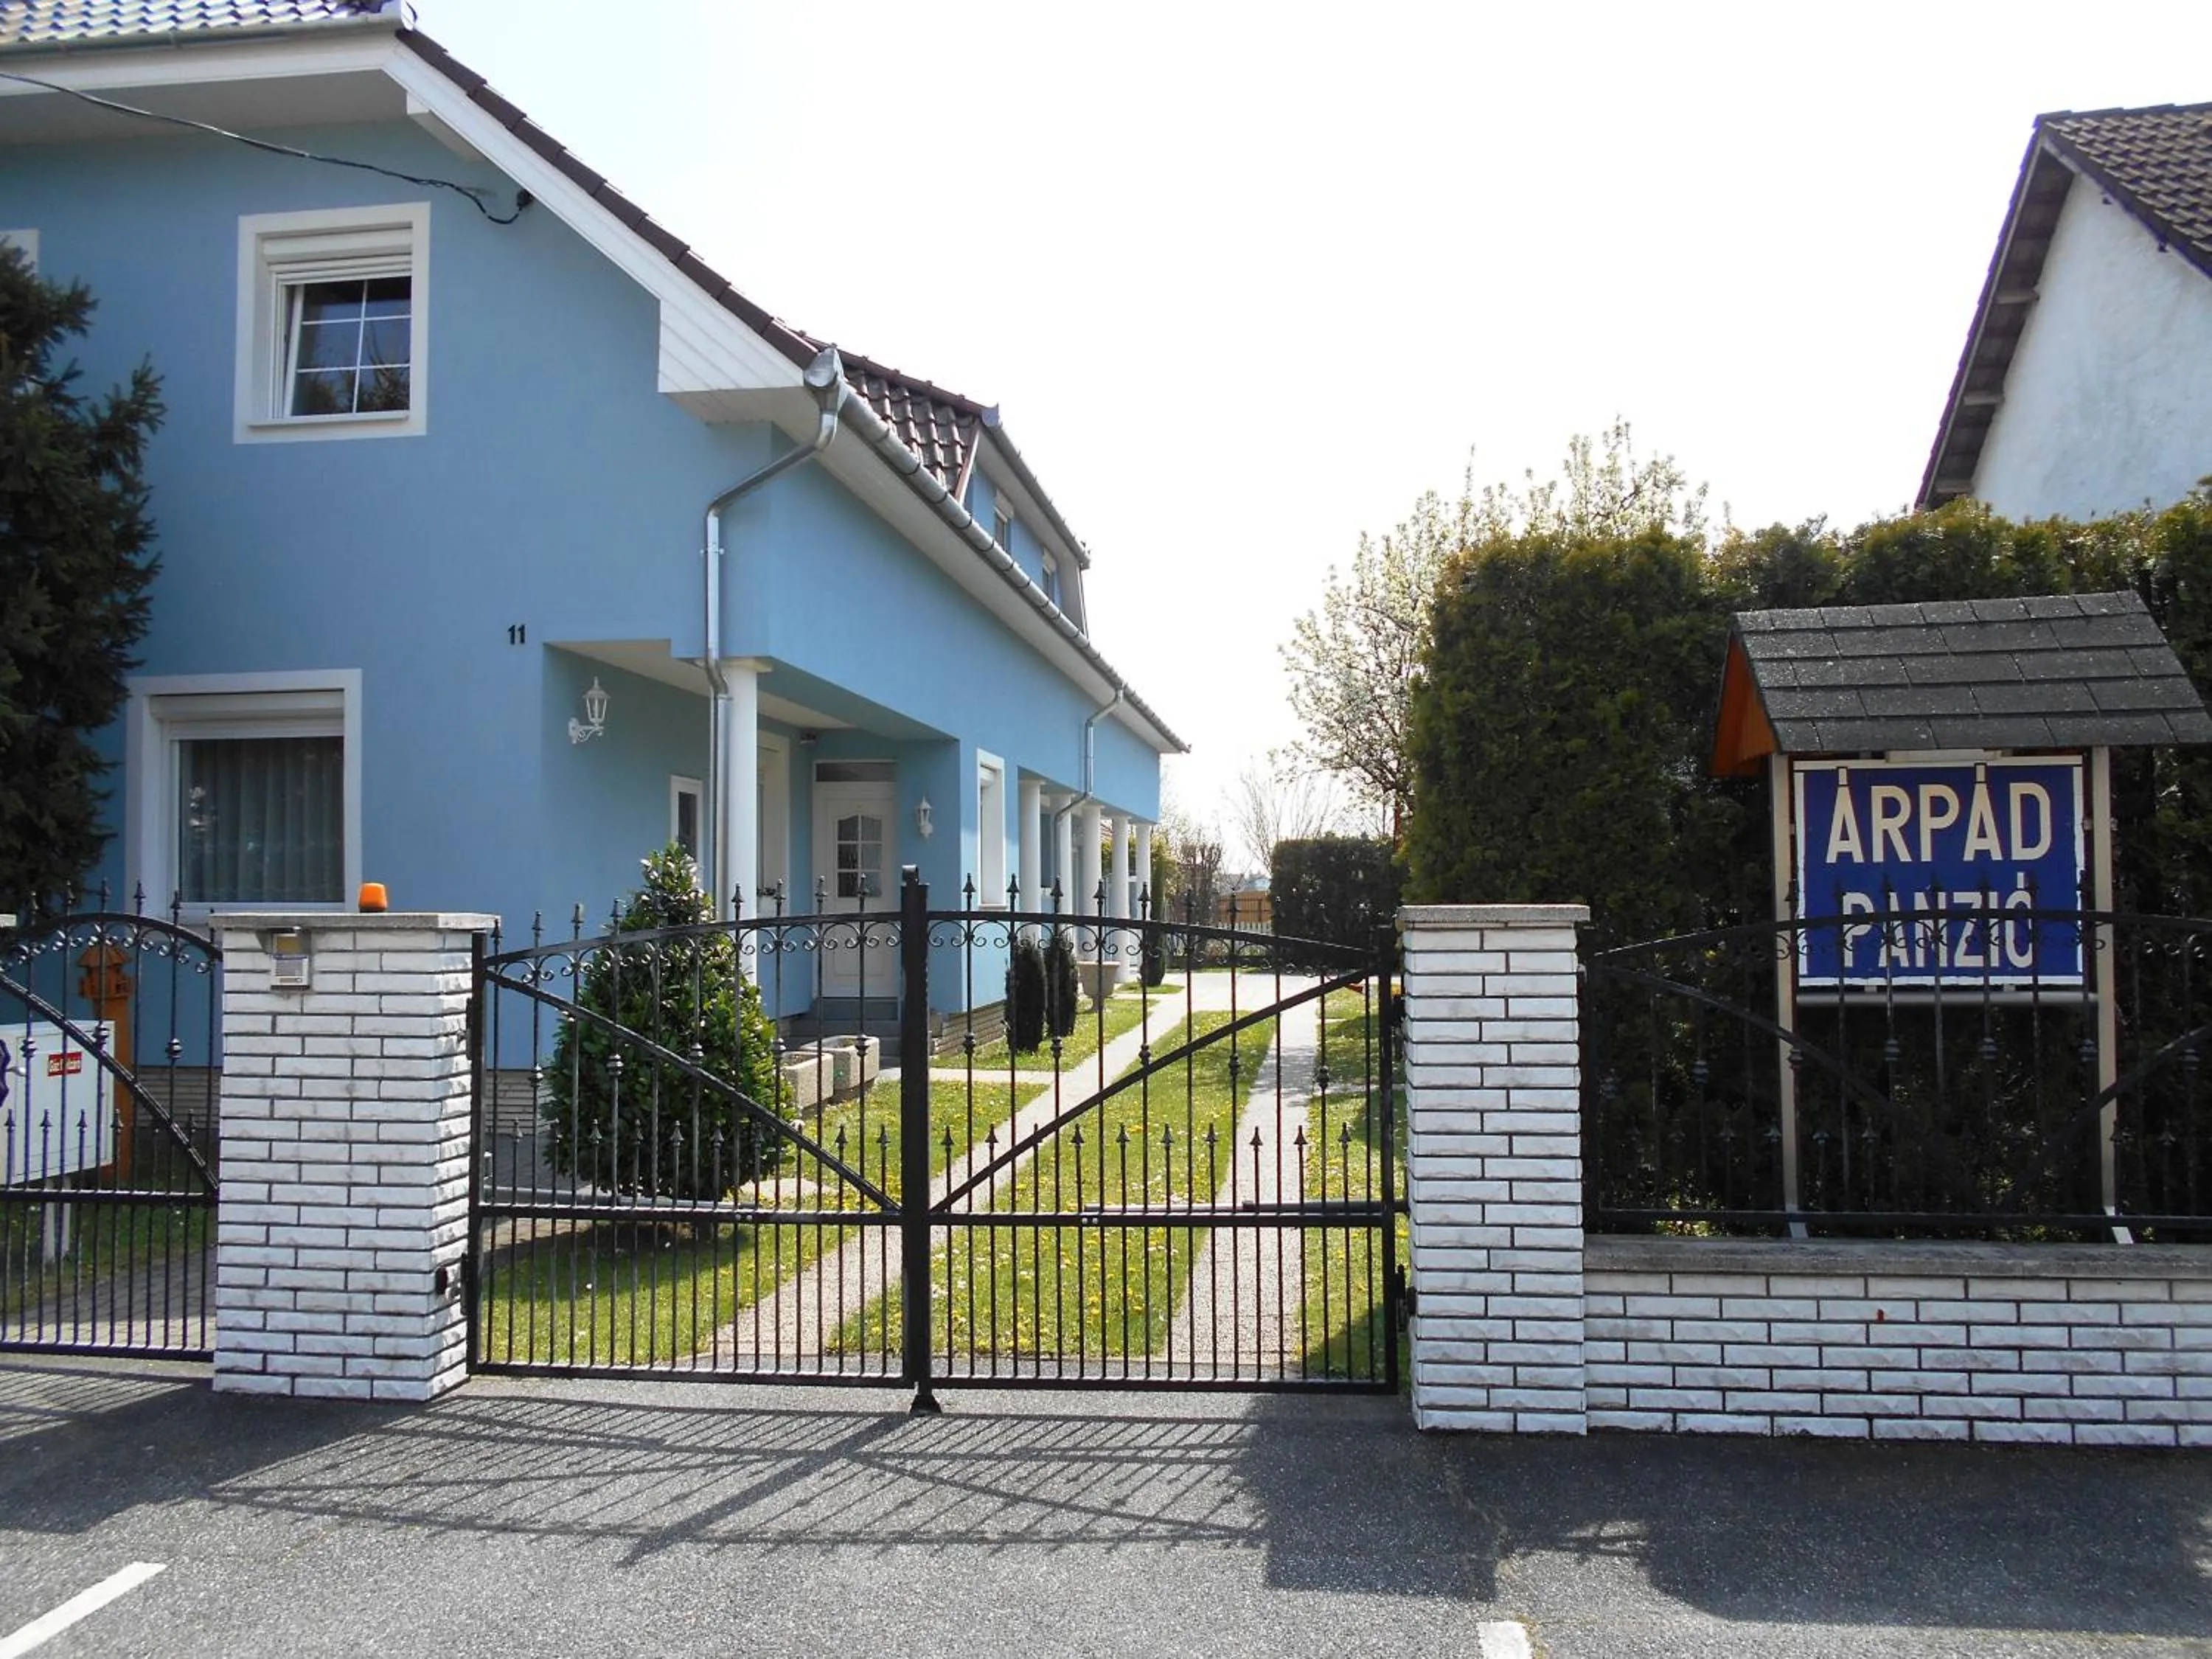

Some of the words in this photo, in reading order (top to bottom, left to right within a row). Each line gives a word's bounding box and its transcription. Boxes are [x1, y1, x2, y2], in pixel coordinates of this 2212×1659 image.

[507, 625, 525, 644] 11
[1825, 764, 2053, 863] ÁRPÁD
[1843, 871, 2034, 968] PANZIÓ
